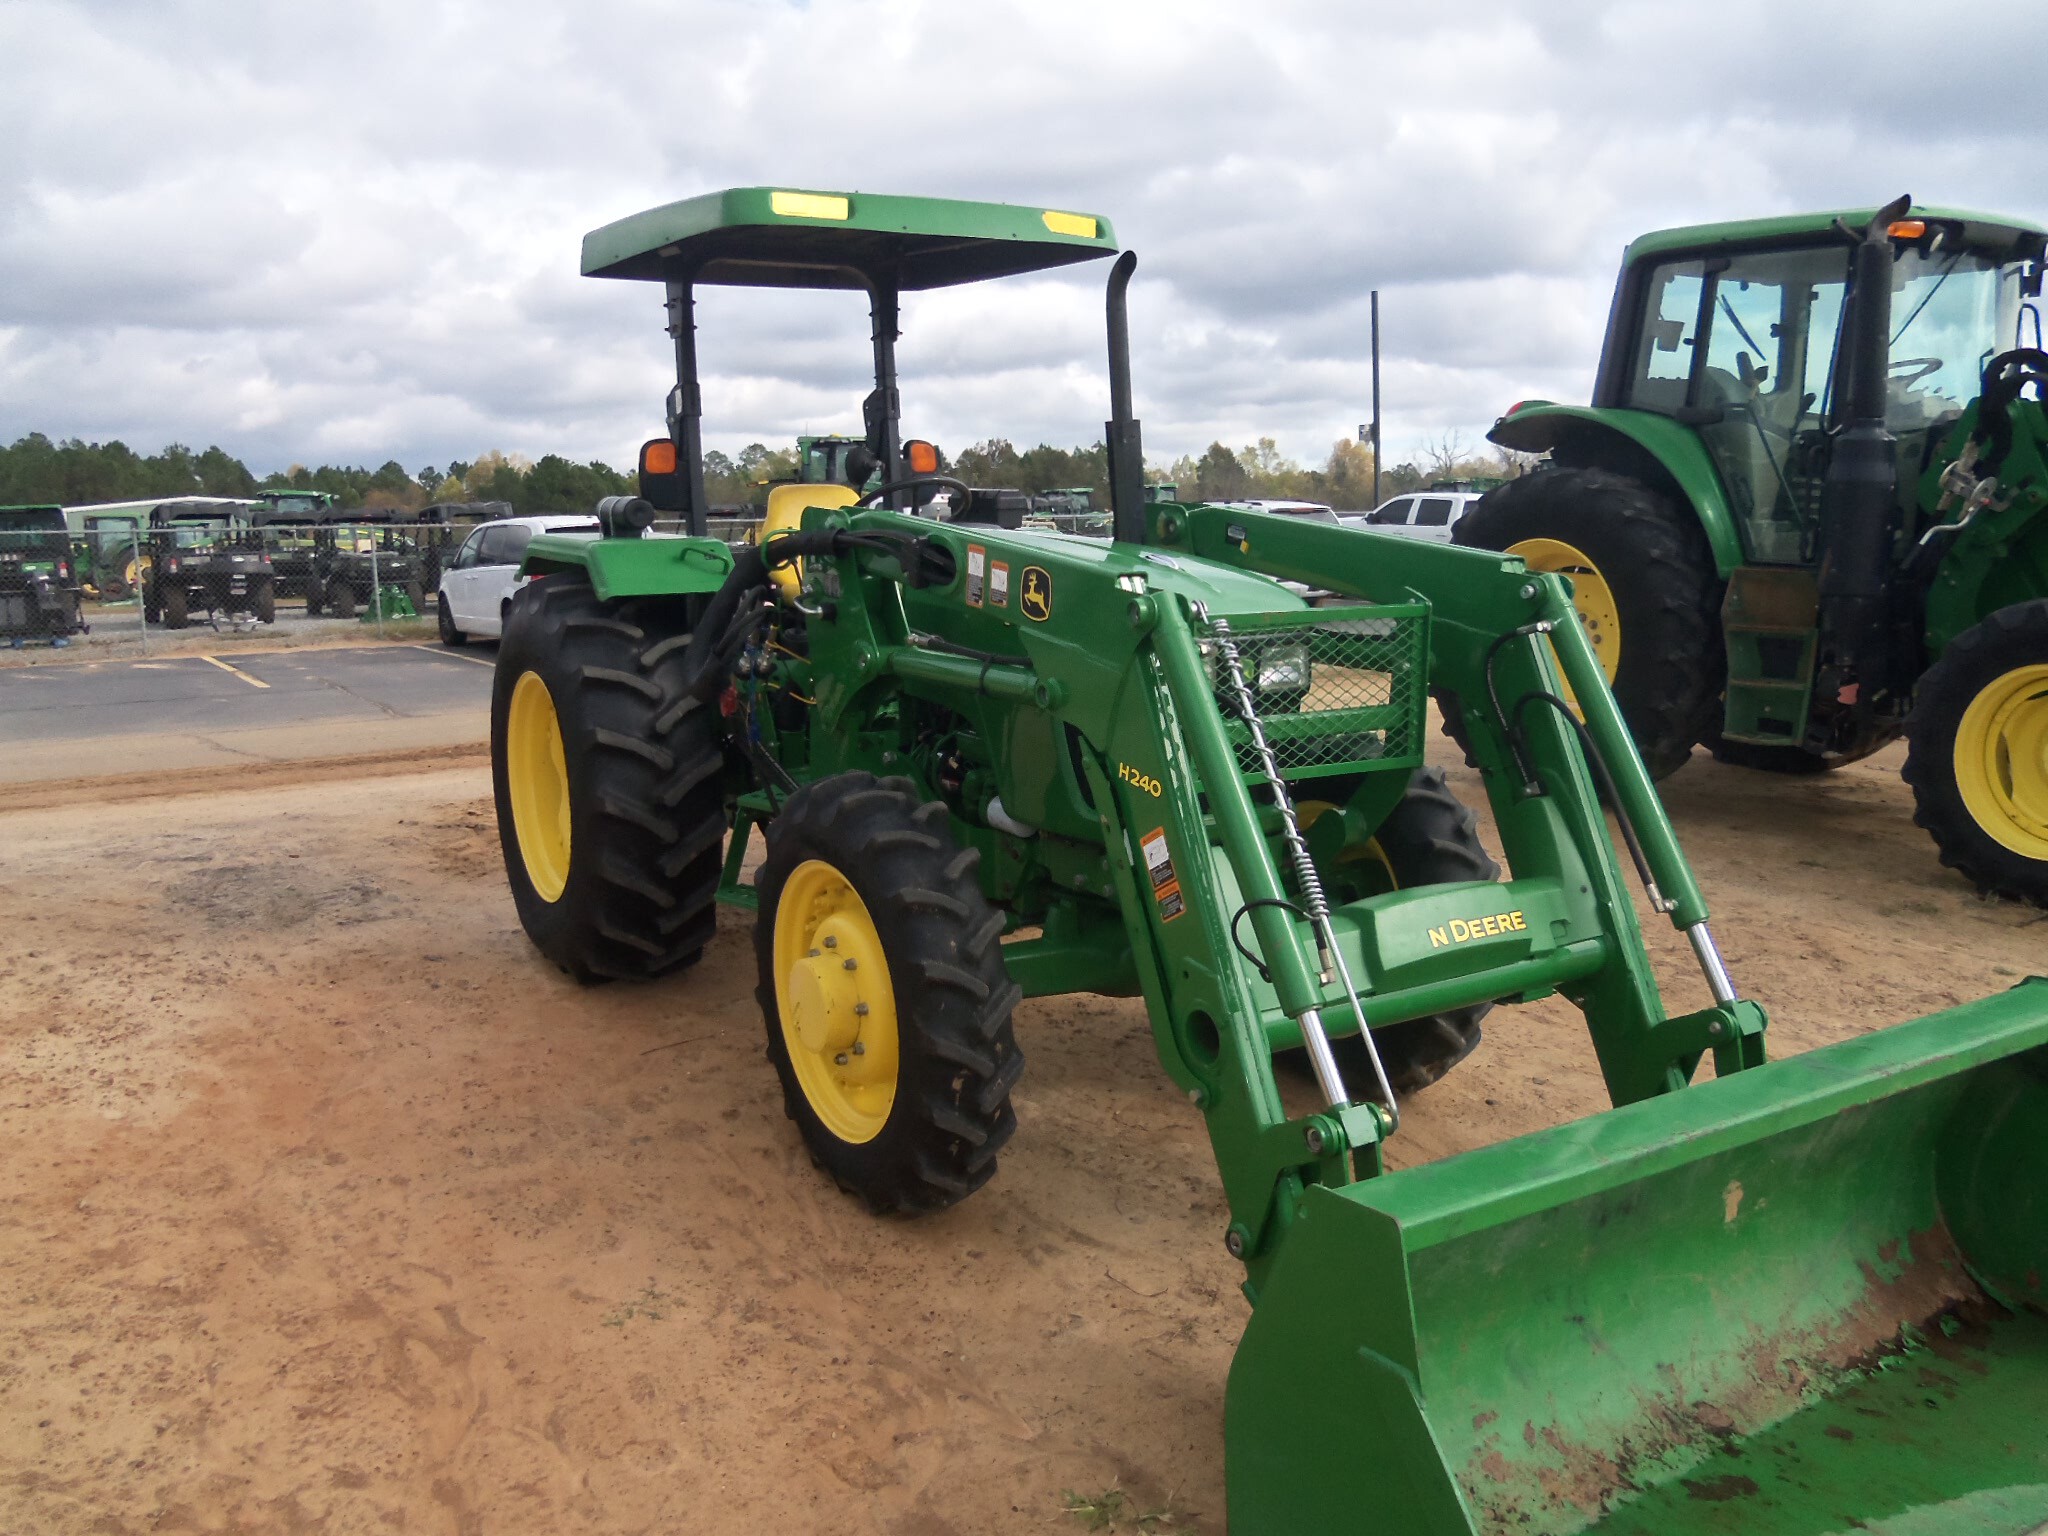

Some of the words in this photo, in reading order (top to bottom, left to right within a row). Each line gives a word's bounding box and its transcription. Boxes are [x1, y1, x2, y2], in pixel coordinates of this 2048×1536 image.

[1118, 762, 1162, 798] H240
[1427, 926, 1449, 948] N
[1449, 910, 1527, 943] DEERE
